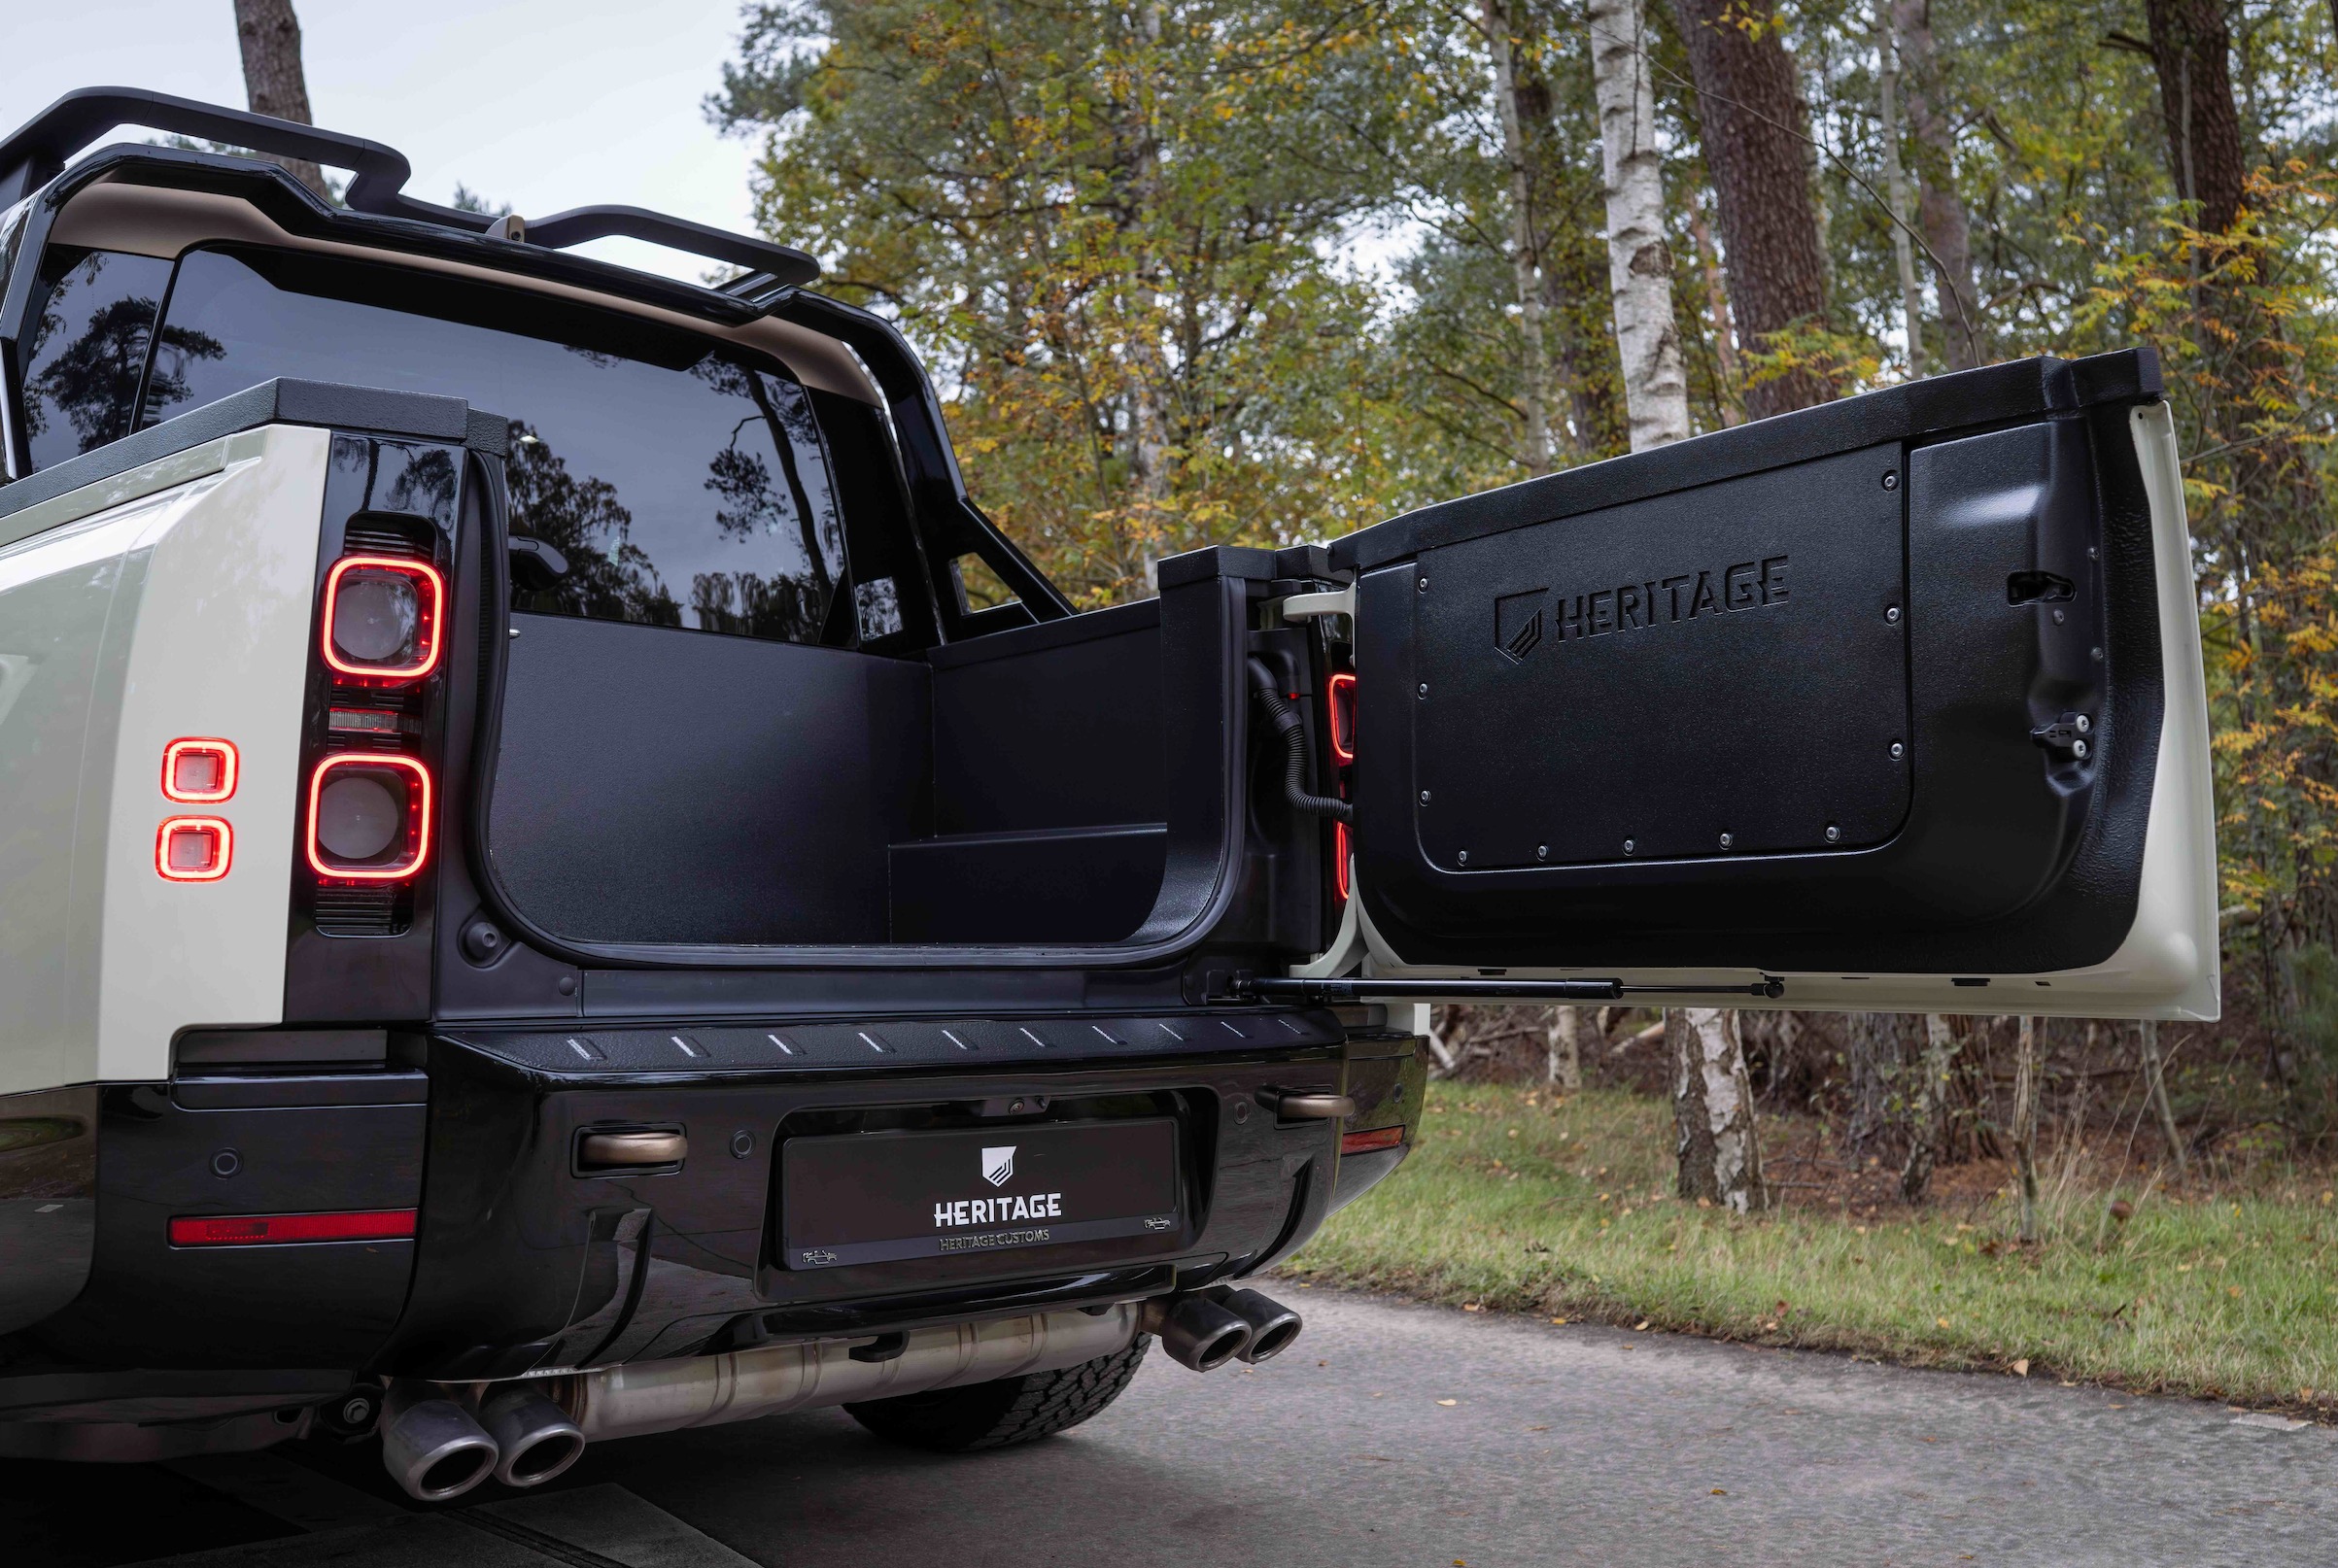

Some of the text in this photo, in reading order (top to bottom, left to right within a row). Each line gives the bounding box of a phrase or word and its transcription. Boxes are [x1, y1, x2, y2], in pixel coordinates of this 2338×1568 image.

[1555, 556, 1788, 642] HERITAGE
[934, 1193, 1061, 1227] HERITAGE
[941, 1229, 1049, 1251] HERITAGE CUSTOMS
